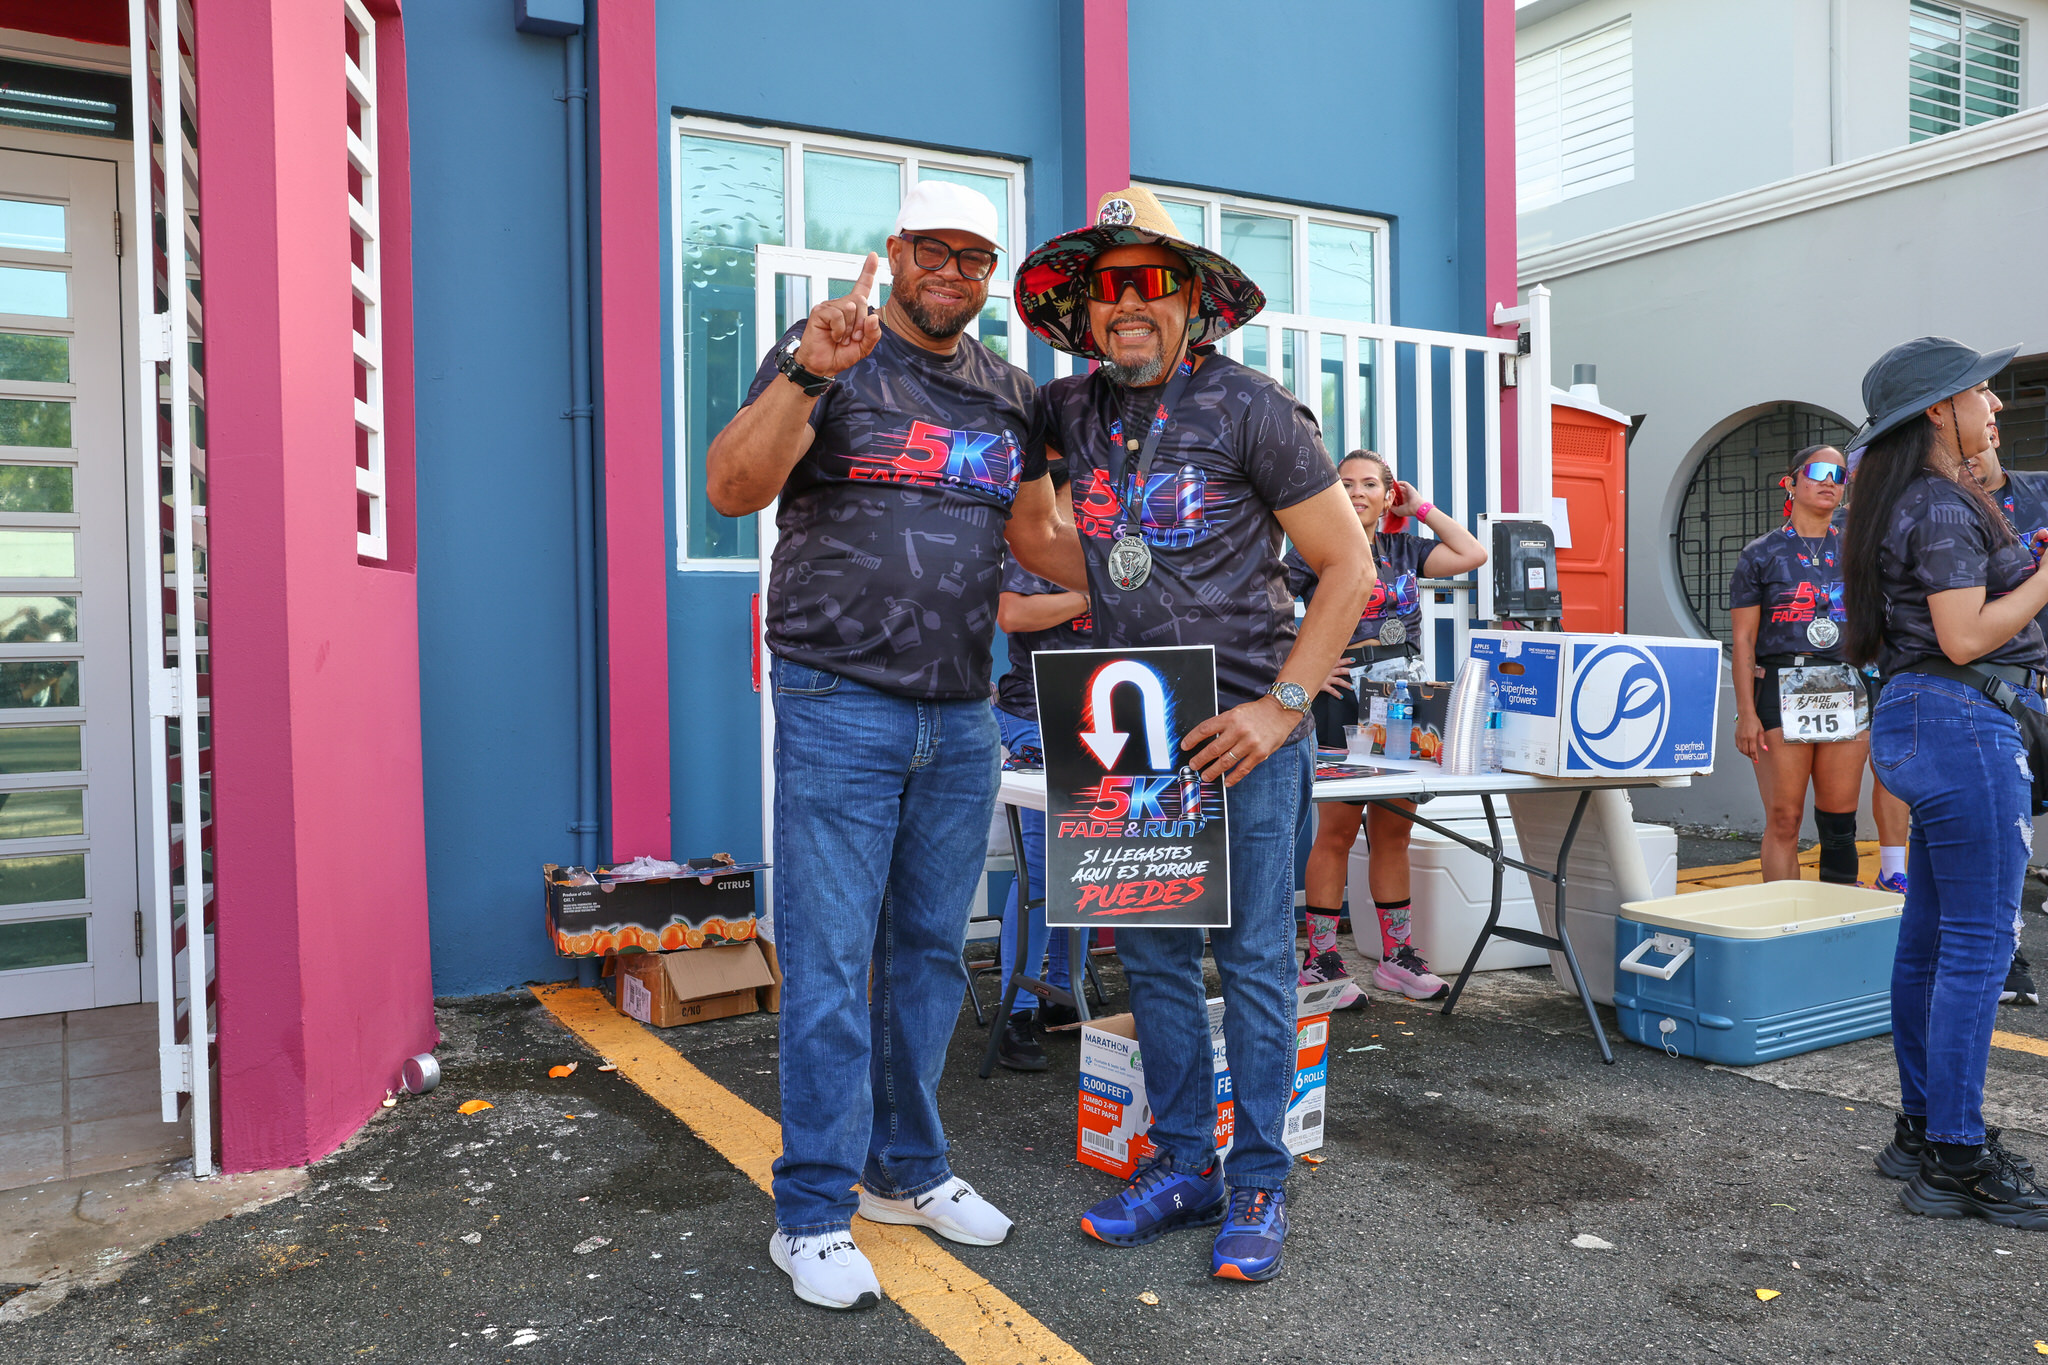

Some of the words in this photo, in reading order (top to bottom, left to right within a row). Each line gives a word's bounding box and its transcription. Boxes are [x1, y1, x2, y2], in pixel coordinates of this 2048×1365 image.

[891, 420, 1002, 483] 5K
[1080, 467, 1176, 527] 5K
[1784, 582, 1845, 611] 5K
[1771, 610, 1815, 623] FADE
[1501, 684, 1538, 698] superfresh
[1508, 694, 1537, 706] growers
[1808, 694, 1832, 703] FADE
[1819, 702, 1840, 710] RUN
[1797, 713, 1839, 735] 215
[1674, 741, 1705, 754] superfresh
[1088, 775, 1178, 820] 5K
[1057, 821, 1125, 838] FADE
[1124, 821, 1142, 838] &
[1143, 821, 1196, 838] RUN
[1077, 847, 1101, 866] SI
[1102, 846, 1193, 865] LLEGASTES
[1116, 864, 1140, 880] ES
[1143, 860, 1210, 880] PORQUE
[717, 879, 751, 891] CITRUS
[1073, 876, 1206, 913] PUEDES
[1085, 1033, 1129, 1054] MARATHON
[1083, 1076, 1107, 1093] 6,000
[1295, 1072, 1304, 1089] 6
[1303, 1069, 1325, 1084] ROLLS
[1082, 1103, 1101, 1115] TOILET
[1101, 1109, 1119, 1122] PAPER
[1083, 1094, 1103, 1107] JUMBO
[1103, 1101, 1118, 1112] 2-PLY
